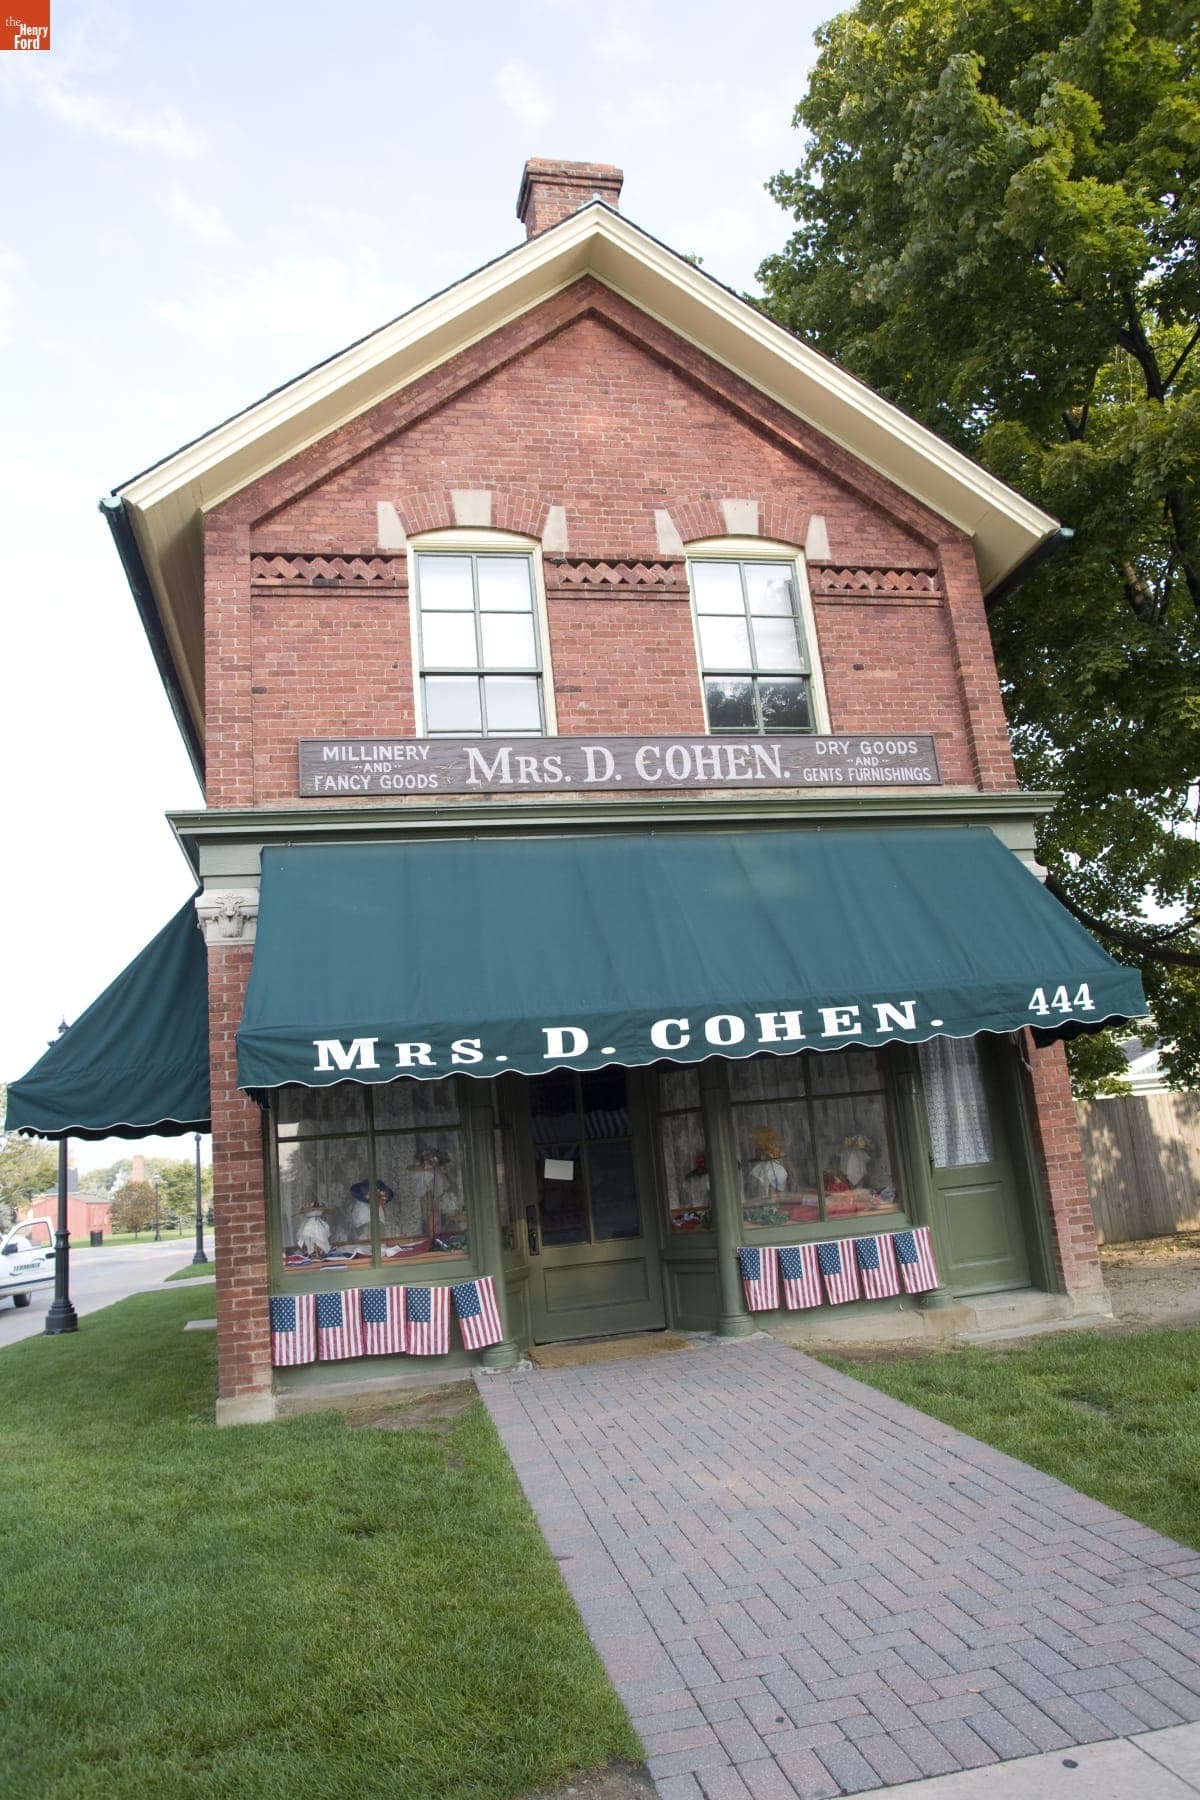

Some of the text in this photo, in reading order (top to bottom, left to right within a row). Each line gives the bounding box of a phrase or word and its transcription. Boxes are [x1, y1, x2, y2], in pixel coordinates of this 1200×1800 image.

[322, 745, 430, 761] MILLINERY
[815, 741, 918, 755] DRY GOODS
[580, 746, 622, 783] D.
[634, 744, 792, 781] COHEN.
[314, 774, 439, 791] FANCY GOODS
[803, 767, 932, 782] GENTS FURNISHINGS
[1027, 983, 1096, 1016] 444
[541, 1026, 616, 1059] D.
[649, 1000, 944, 1050] COHEN.
